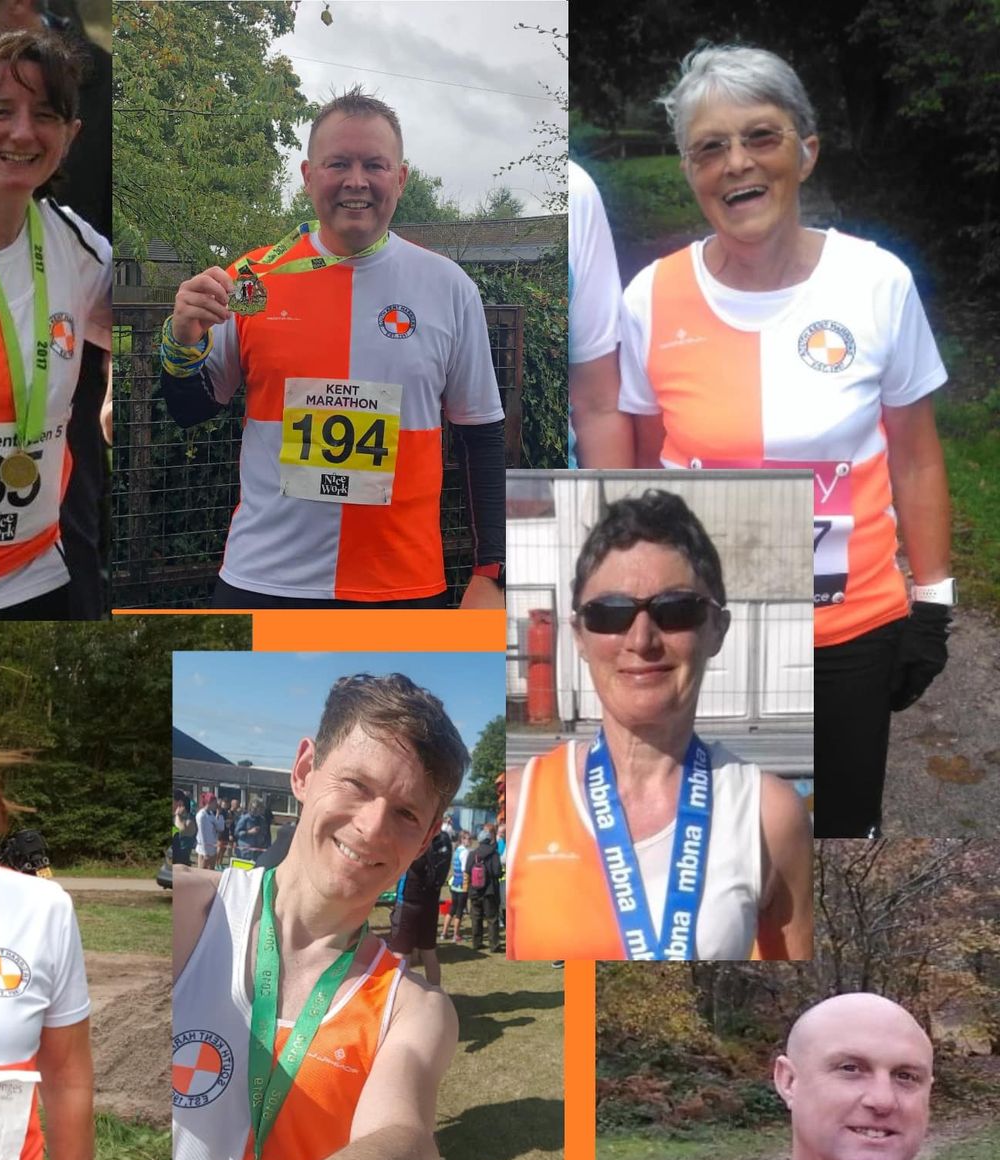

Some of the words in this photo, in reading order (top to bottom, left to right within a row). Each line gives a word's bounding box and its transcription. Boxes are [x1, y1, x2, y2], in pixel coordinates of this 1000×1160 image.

[34, 244, 45, 273] 2017
[36, 341, 48, 370] 2017
[306, 395, 378, 410] MARATHON
[326, 384, 360, 396] KENT
[55, 425, 64, 438] 5
[292, 414, 389, 467] 194
[321, 483, 348, 496] Work
[324, 474, 347, 486] Nice
[588, 766, 616, 829] mbna
[675, 825, 703, 892] mbna
[604, 846, 636, 913] mbna
[664, 911, 692, 960] bna
